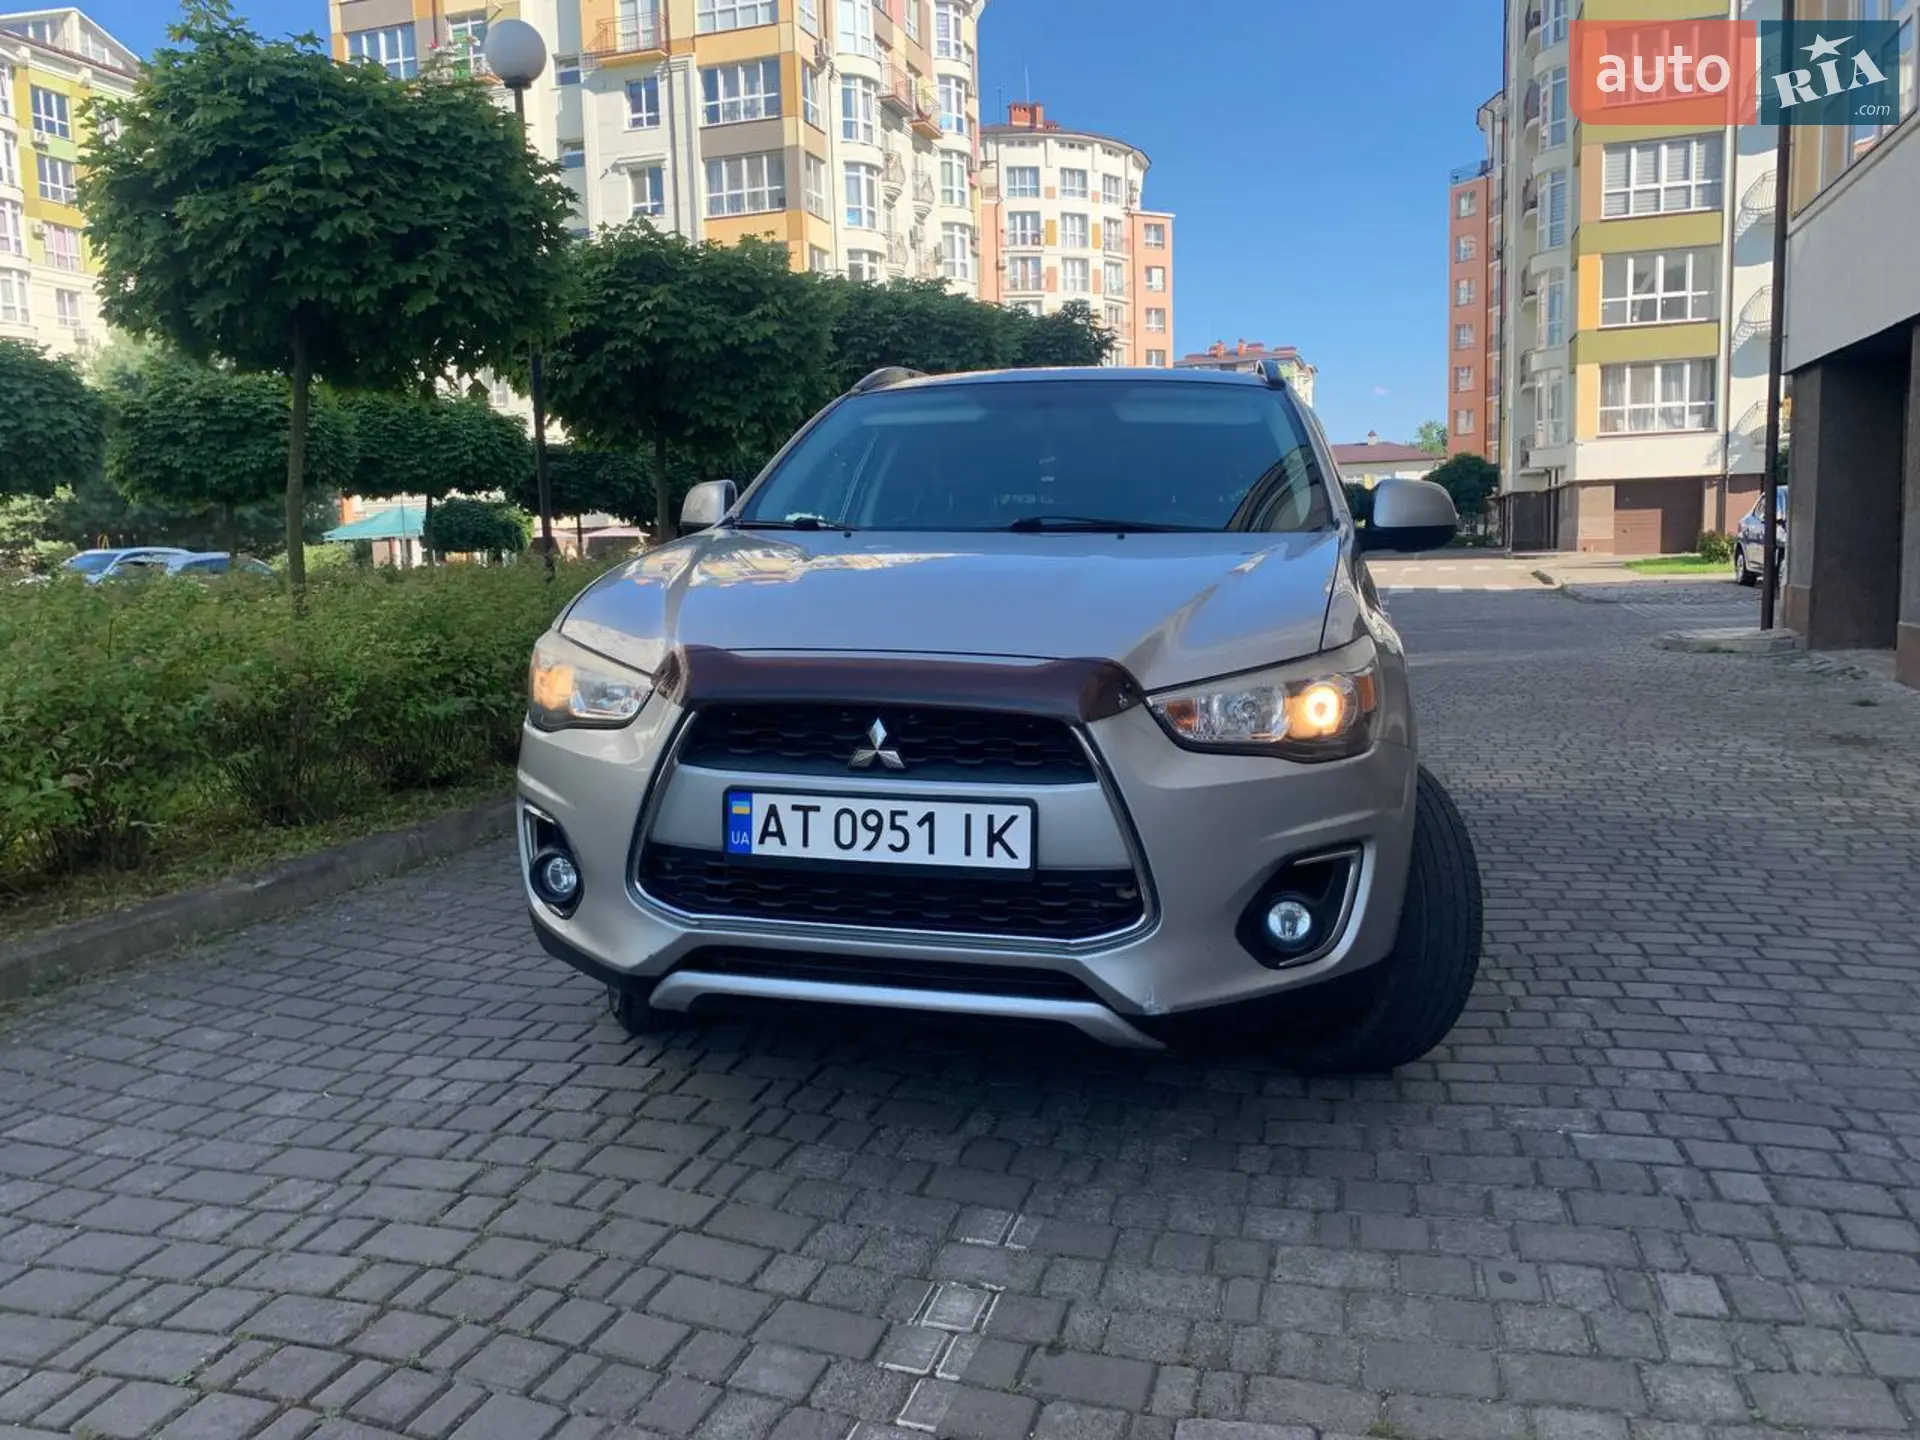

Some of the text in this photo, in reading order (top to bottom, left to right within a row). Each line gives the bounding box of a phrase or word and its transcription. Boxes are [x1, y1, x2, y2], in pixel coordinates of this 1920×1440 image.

[731, 831, 750, 845] UA
[758, 803, 1019, 860] AT 0951 IK
